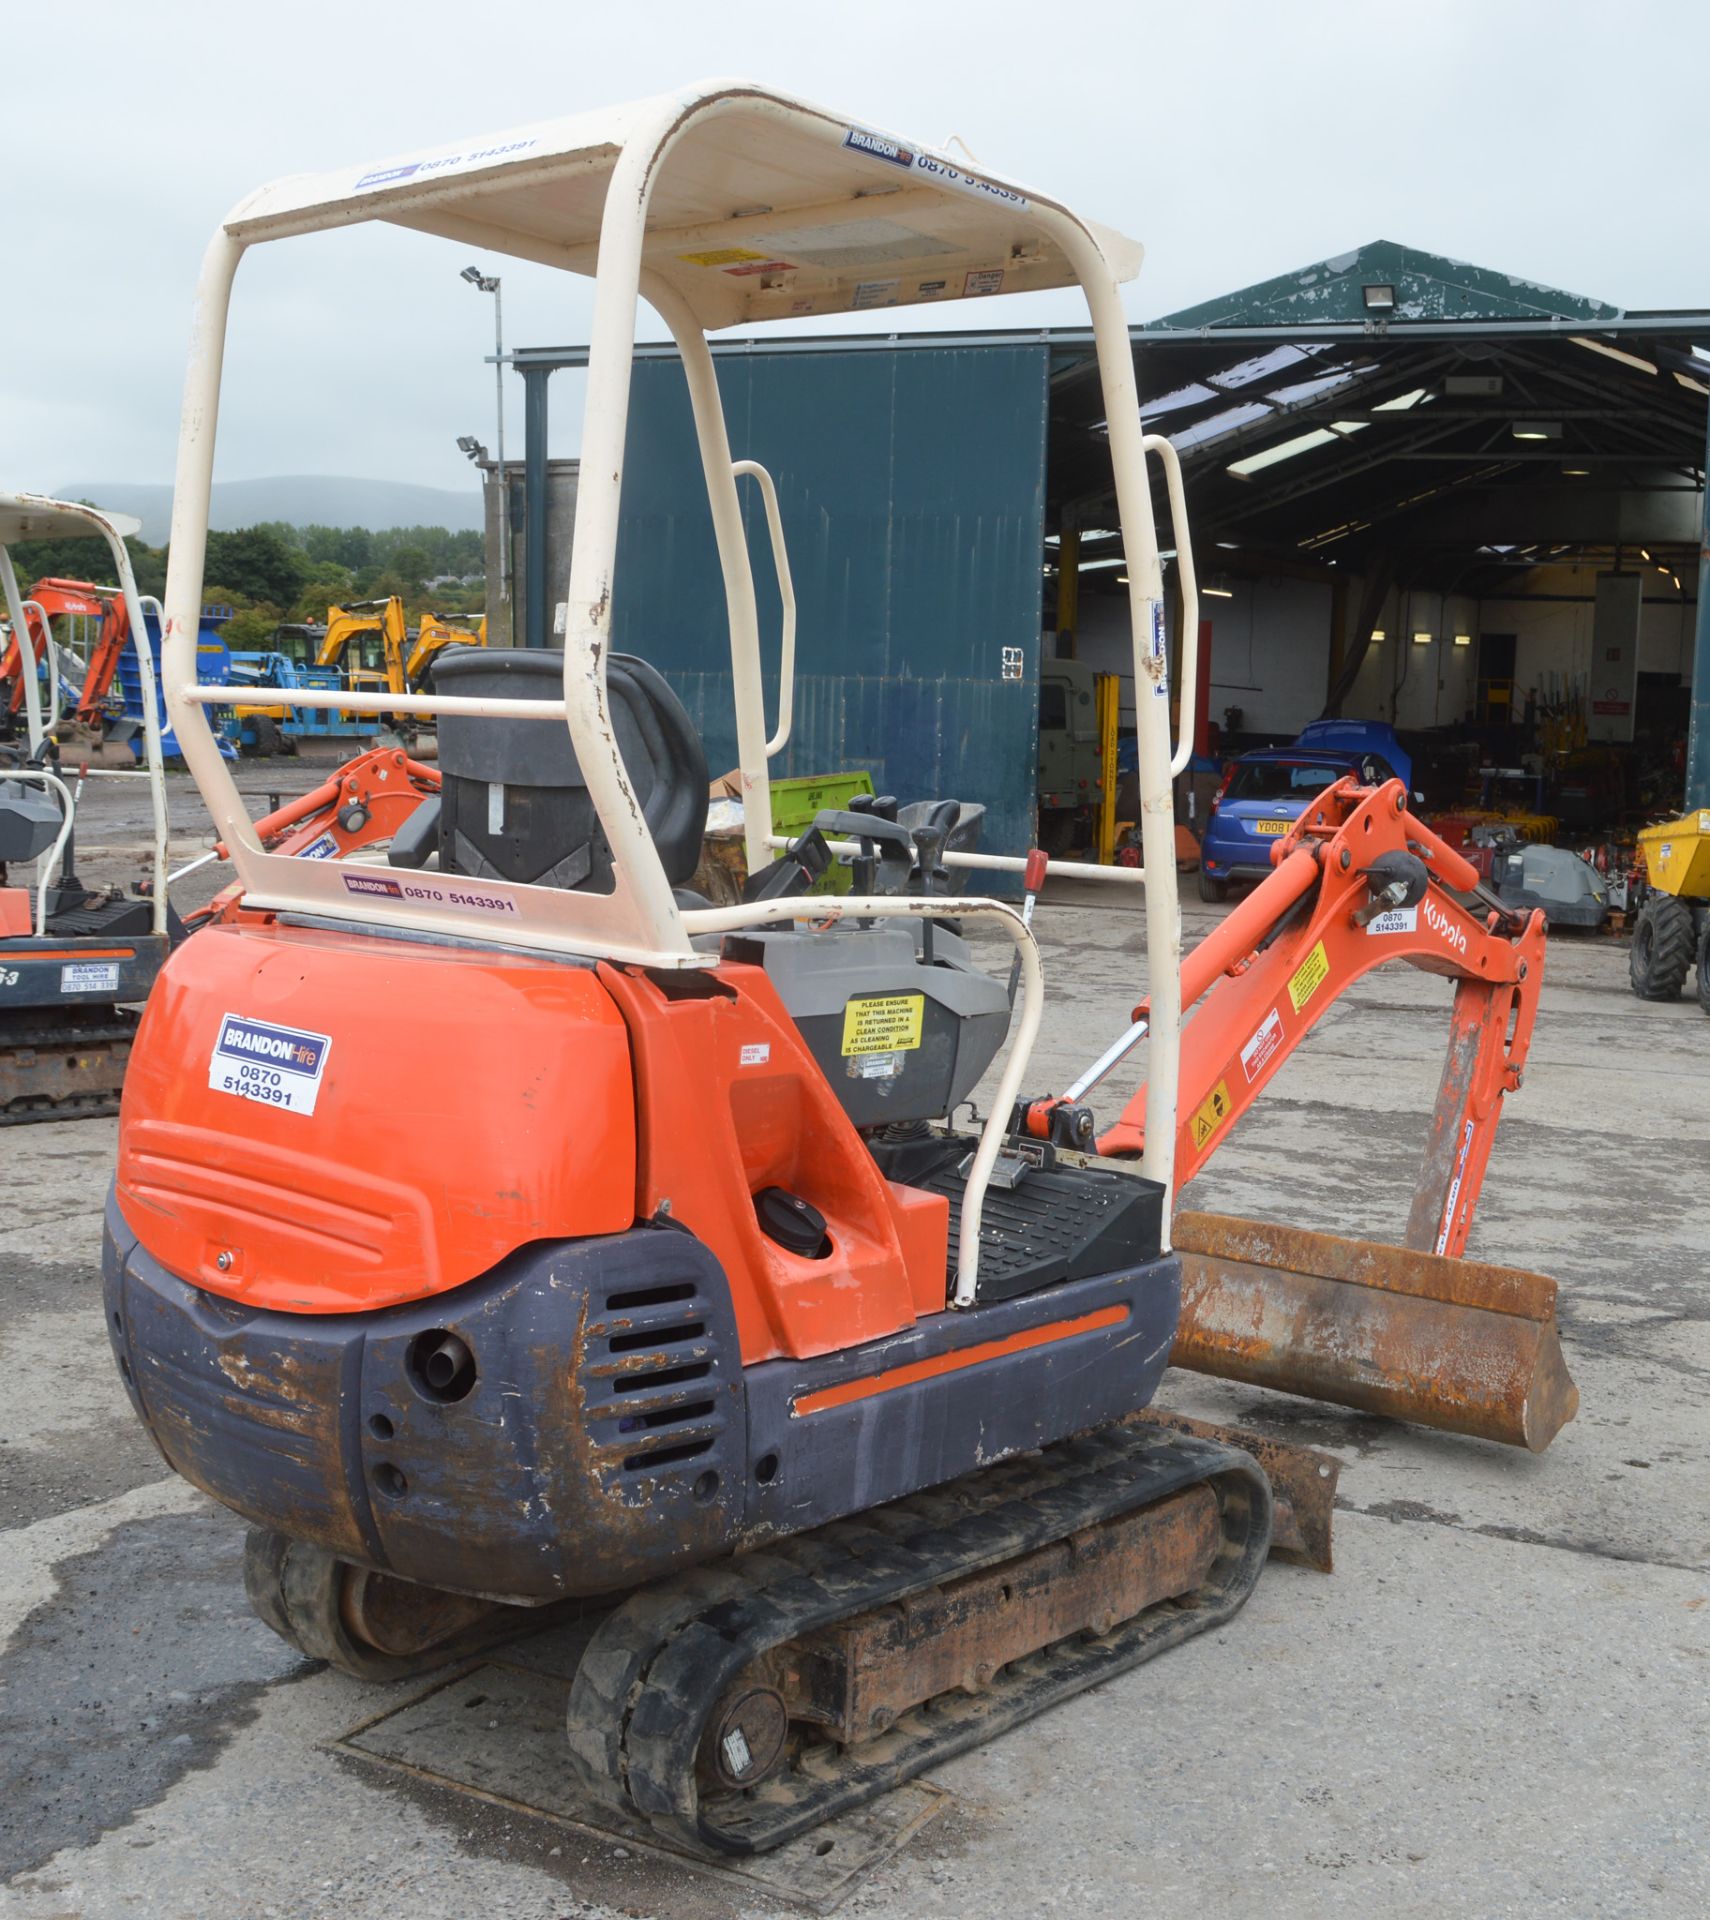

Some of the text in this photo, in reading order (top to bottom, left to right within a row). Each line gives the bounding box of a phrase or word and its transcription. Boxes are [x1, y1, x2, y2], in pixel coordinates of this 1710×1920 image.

[420, 156, 462, 171] 0870
[467, 139, 537, 162] 5143391
[404, 887, 443, 901] 0870
[449, 893, 515, 912] 5143391
[1382, 912, 1403, 923] 0870
[1375, 922, 1408, 932] 5143391
[1423, 898, 1467, 954] Kubota
[72, 967, 109, 975] BRANDON
[864, 1017, 896, 1026] RETURNED
[856, 1025, 909, 1036] CLEAN CONDITION
[860, 1035, 890, 1043] CLEANING
[853, 1044, 893, 1052] CHARGEABLE
[240, 1065, 281, 1086] 0870
[223, 1076, 292, 1106] 5143391
